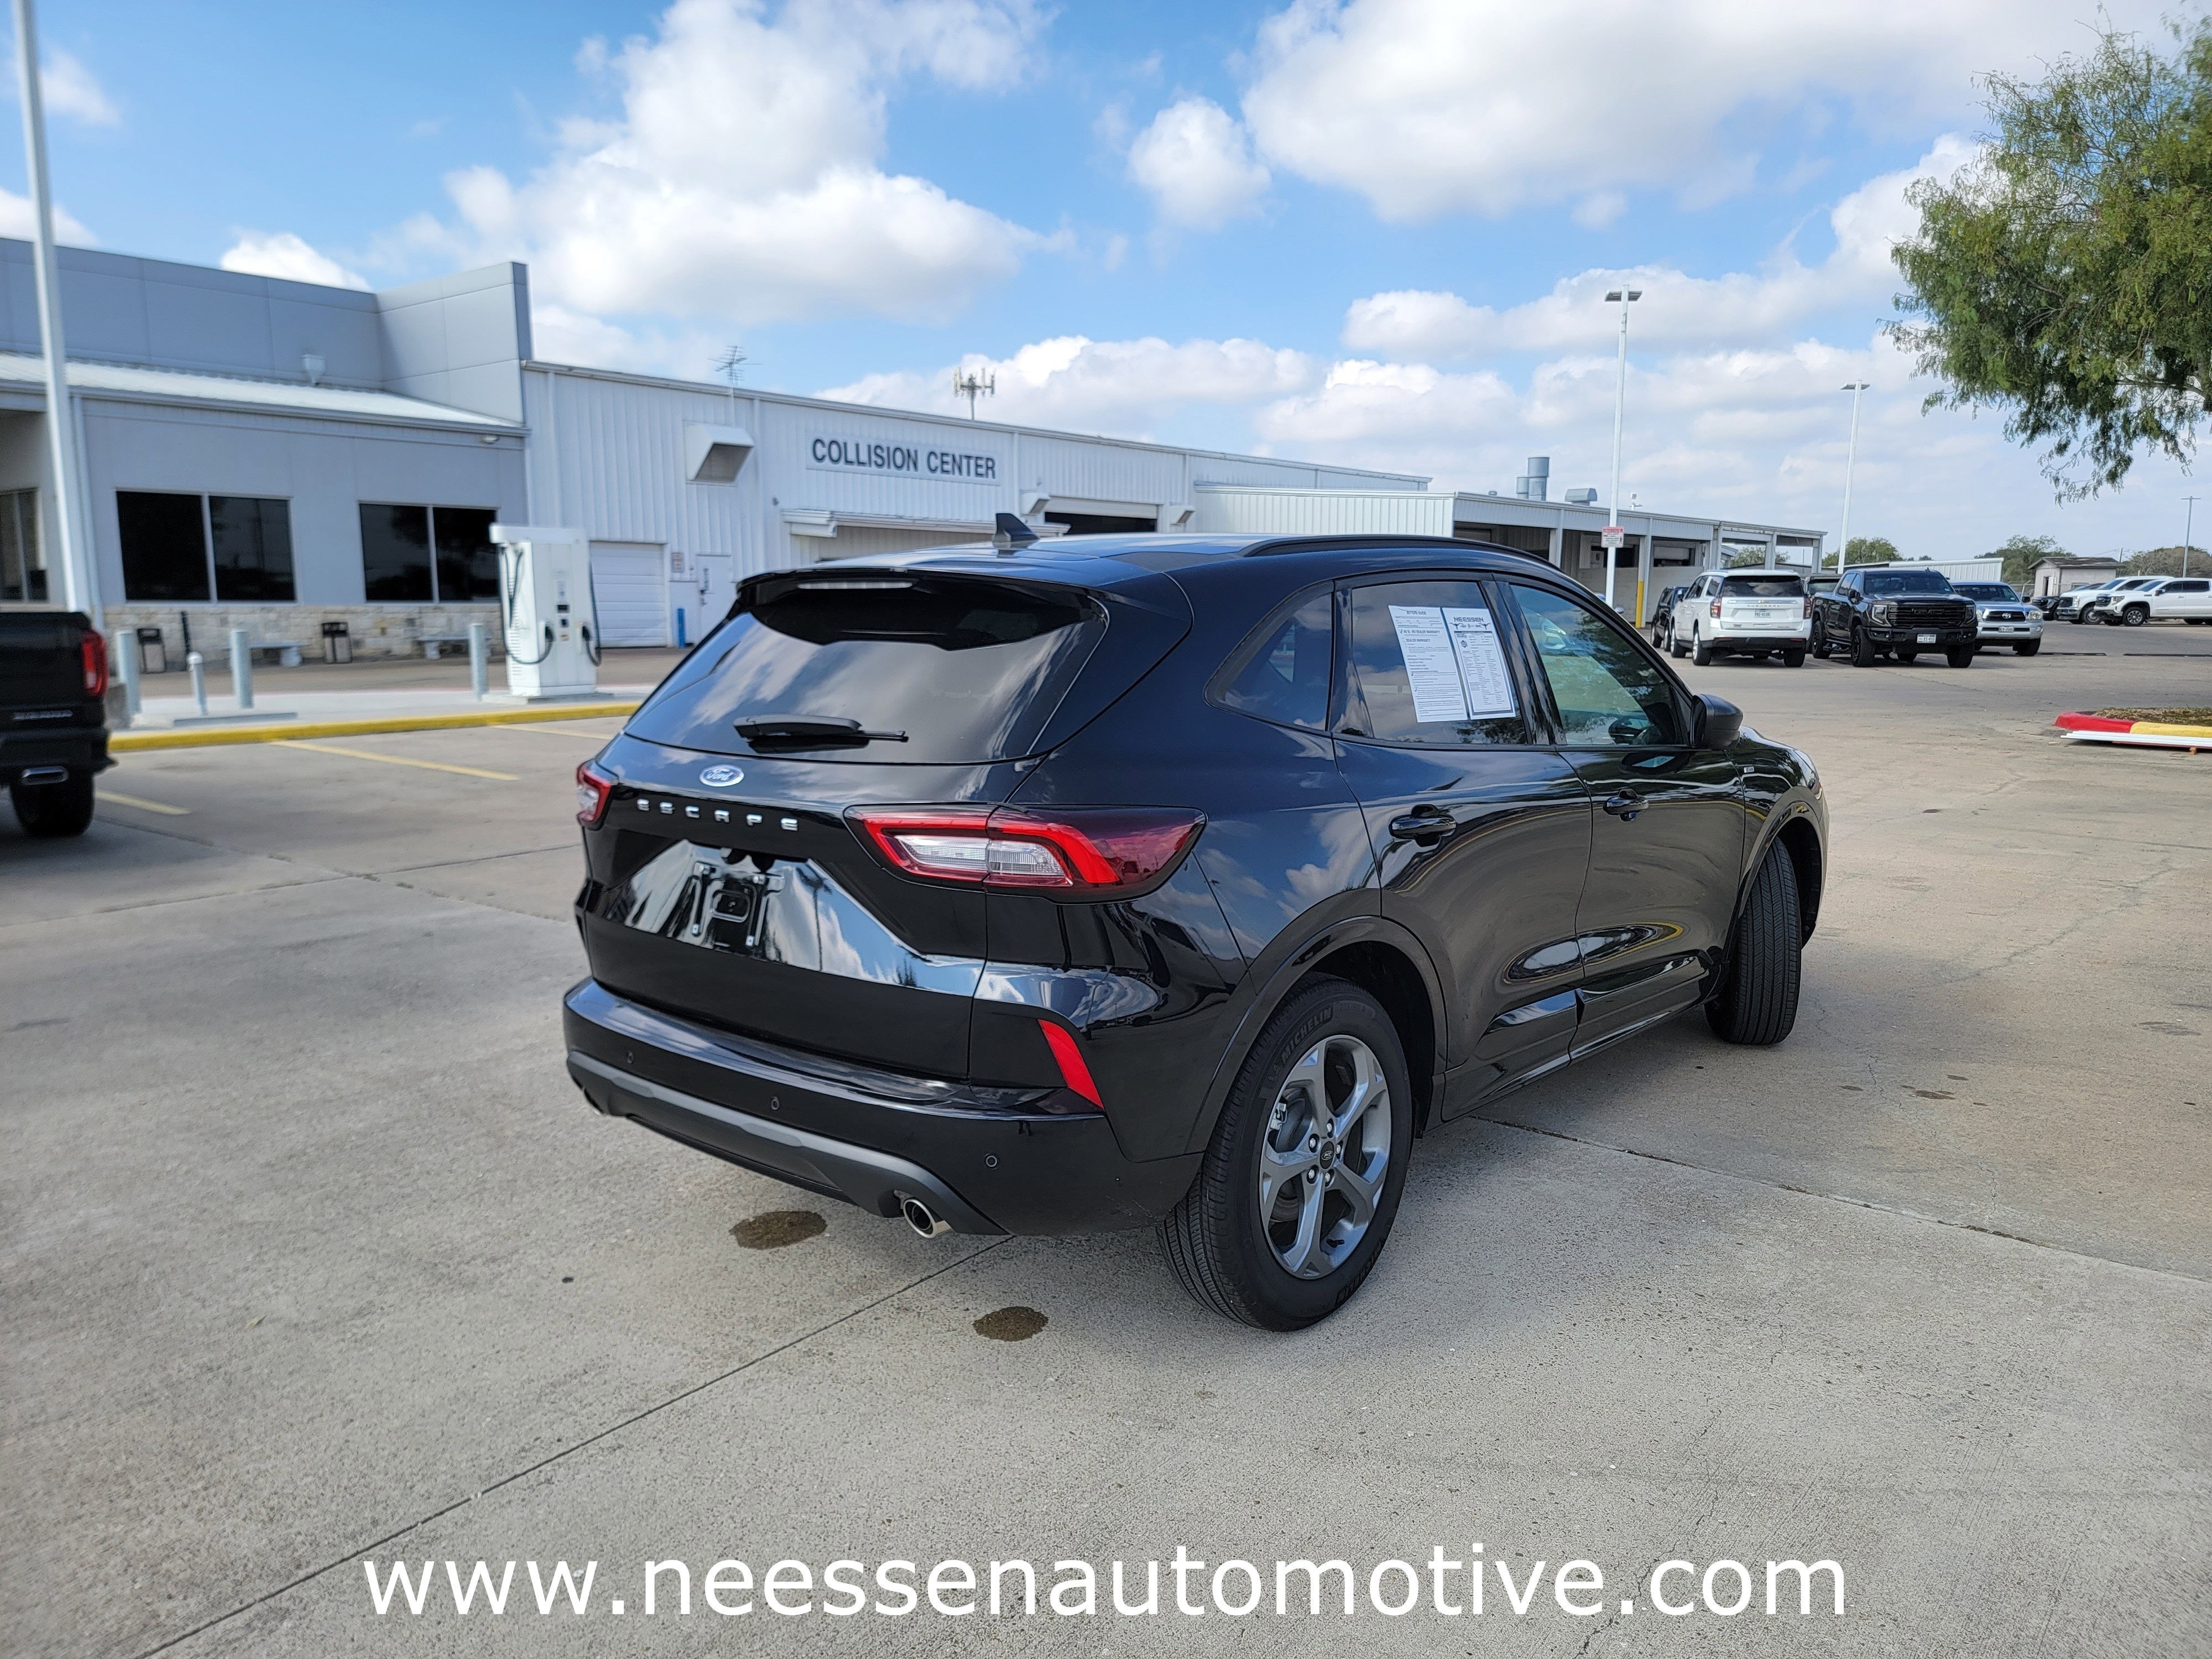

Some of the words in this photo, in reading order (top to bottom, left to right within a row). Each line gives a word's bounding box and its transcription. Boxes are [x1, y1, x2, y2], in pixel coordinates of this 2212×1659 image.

[812, 439, 918, 472] COLLISION
[927, 451, 995, 479] CENTER
[706, 767, 734, 781] Ford
[637, 799, 798, 831] ESCAPE
[1281, 1006, 1332, 1062] MICHELIN
